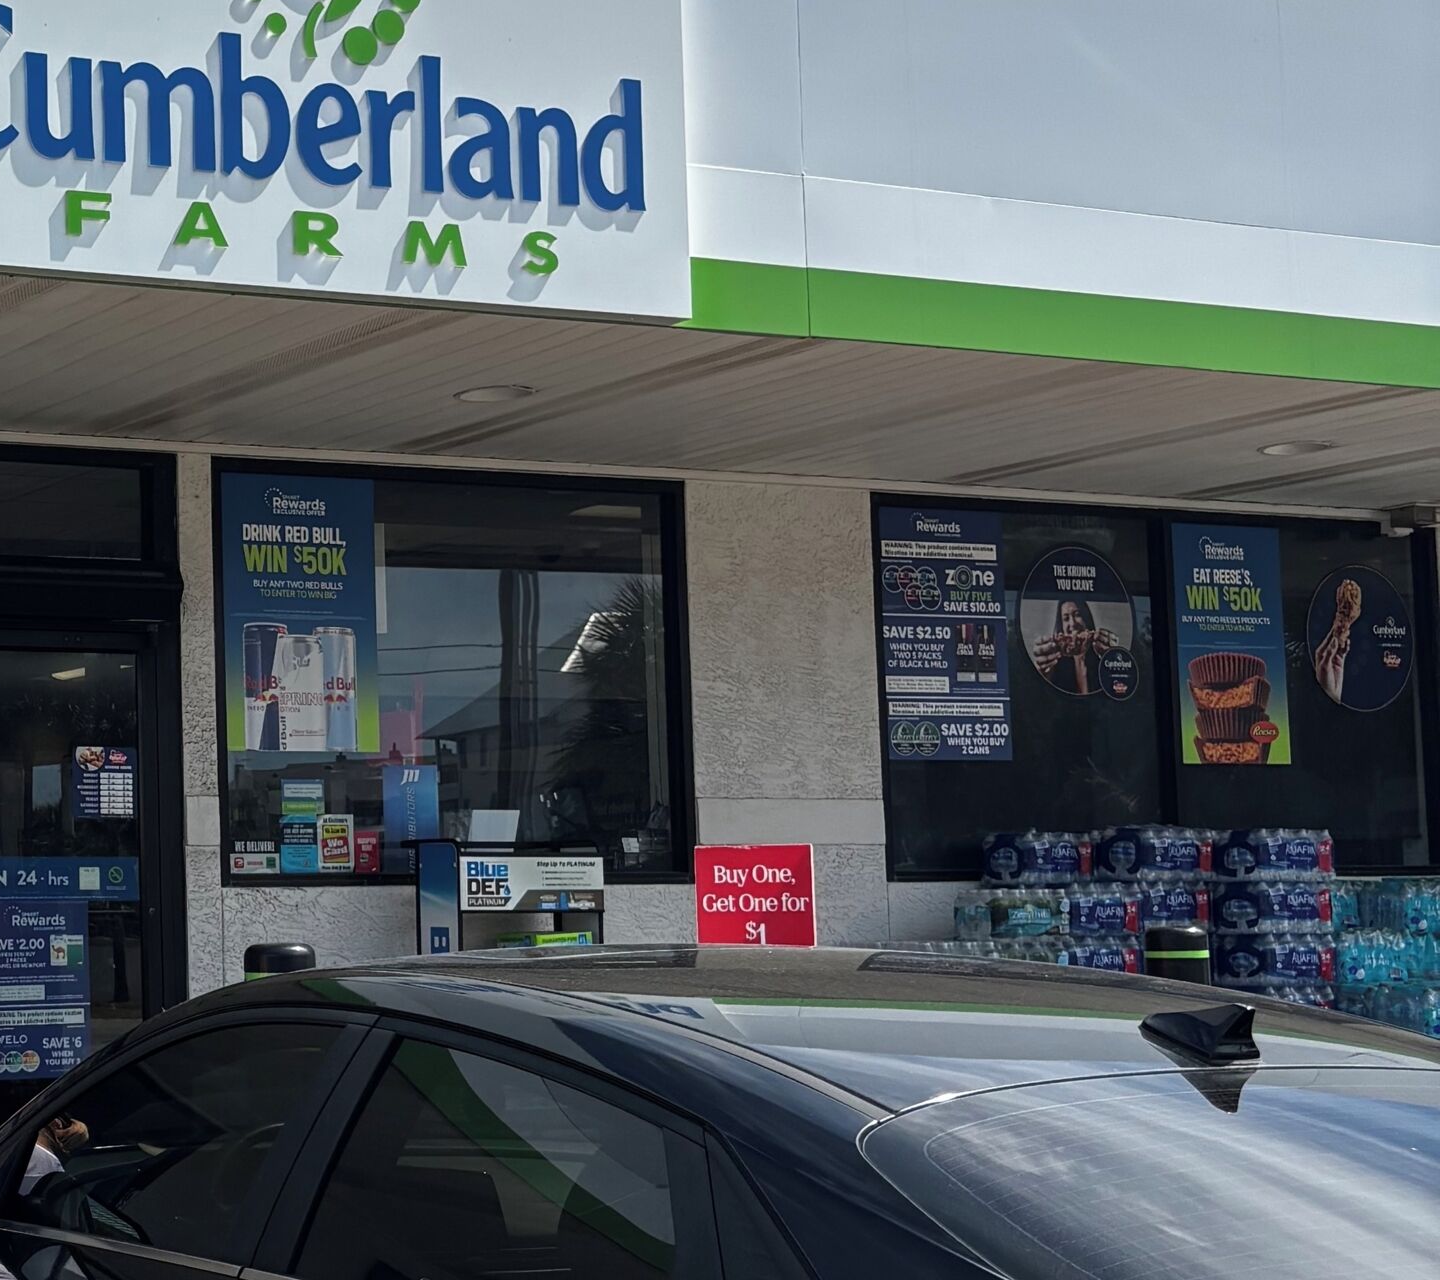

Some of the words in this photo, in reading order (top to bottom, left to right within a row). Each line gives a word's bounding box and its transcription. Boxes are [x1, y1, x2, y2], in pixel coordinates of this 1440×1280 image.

[65, 190, 559, 276] FARMS
[272, 496, 326, 511] Rewards
[272, 508, 306, 516] EXCLUSIVE
[916, 520, 961, 533] Rewards
[242, 523, 282, 542] DRINK
[284, 525, 309, 544] RED
[312, 527, 346, 547] BULL,
[1205, 544, 1244, 556] Rewards
[243, 543, 288, 573] WIN
[293, 545, 347, 576] $50K
[945, 565, 995, 590] zone
[1053, 565, 1066, 577] THE
[1067, 566, 1096, 577] KRUNCH
[1193, 567, 1212, 584] EAT
[1213, 568, 1253, 587] REESE'S,
[253, 579, 269, 588] BUY
[269, 580, 286, 588] ANY
[286, 580, 304, 589] TWO
[305, 581, 320, 589] RED
[320, 581, 344, 590] BULLS
[1057, 579, 1071, 591] YOU
[1071, 580, 1094, 591] CRAVE
[261, 589, 271, 597] TO
[271, 589, 296, 598] ENTER
[296, 590, 307, 598] TO
[307, 590, 324, 599] WIN
[324, 591, 337, 599] BIG
[950, 591, 969, 601] BUY
[971, 591, 992, 601] FIVE
[1186, 585, 1219, 611] WIN
[1223, 586, 1263, 612] $50K
[943, 602, 969, 612] SAVE
[970, 602, 1001, 613] $10.00
[882, 625, 914, 639] SAVE
[916, 626, 951, 640] $2.50
[941, 723, 972, 736] SAVE
[974, 723, 1009, 736] $2.00
[234, 841, 245, 852] WE
[326, 838, 343, 848] We
[324, 846, 348, 856] Card
[467, 861, 509, 877] Blue
[17, 870, 38, 886] 24
[48, 870, 69, 886] hrs
[713, 865, 749, 888] Buy
[752, 864, 796, 885] One,
[467, 878, 508, 895] DEF
[468, 897, 505, 906] PLATINUM
[702, 893, 736, 913] Get
[739, 893, 778, 912] One
[781, 892, 810, 912] for
[12, 914, 66, 927] Rewards
[745, 920, 767, 945] $1
[16, 938, 45, 950] $2.00
[42, 1037, 70, 1049] SAVE
